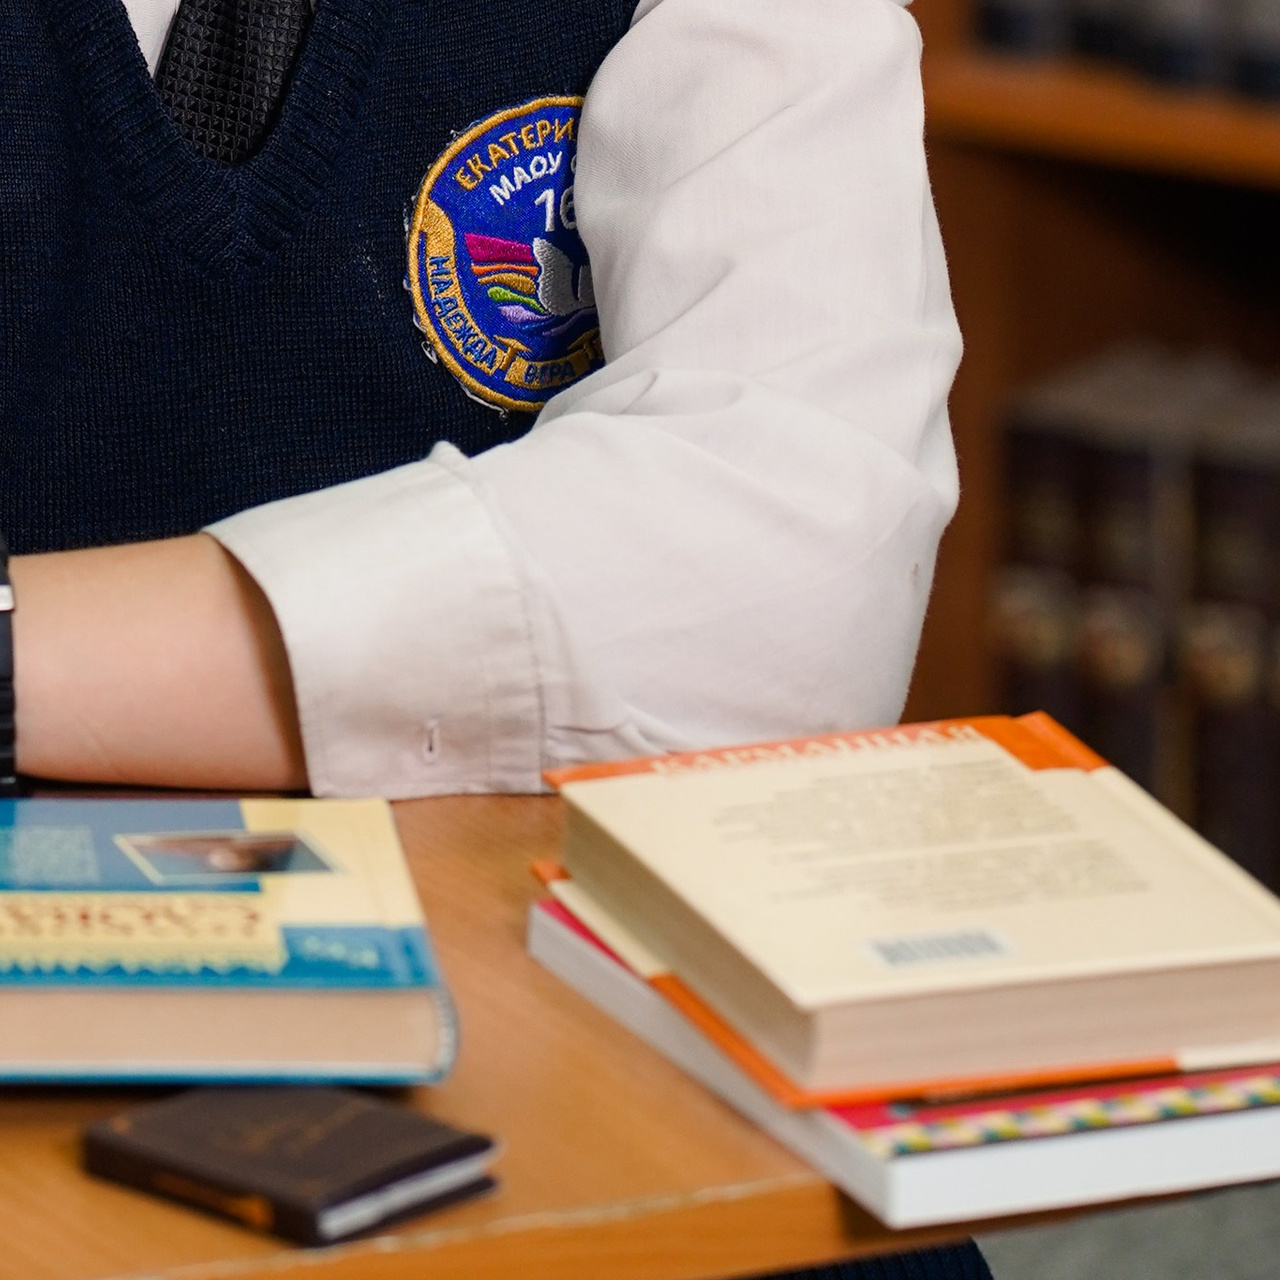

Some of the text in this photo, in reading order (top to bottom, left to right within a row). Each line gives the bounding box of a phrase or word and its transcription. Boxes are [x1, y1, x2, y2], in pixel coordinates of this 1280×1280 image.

[455, 117, 574, 191] ЕКАТЕРИ
[488, 151, 563, 206] МАОУ
[428, 255, 499, 371] НАДЕЖДА
